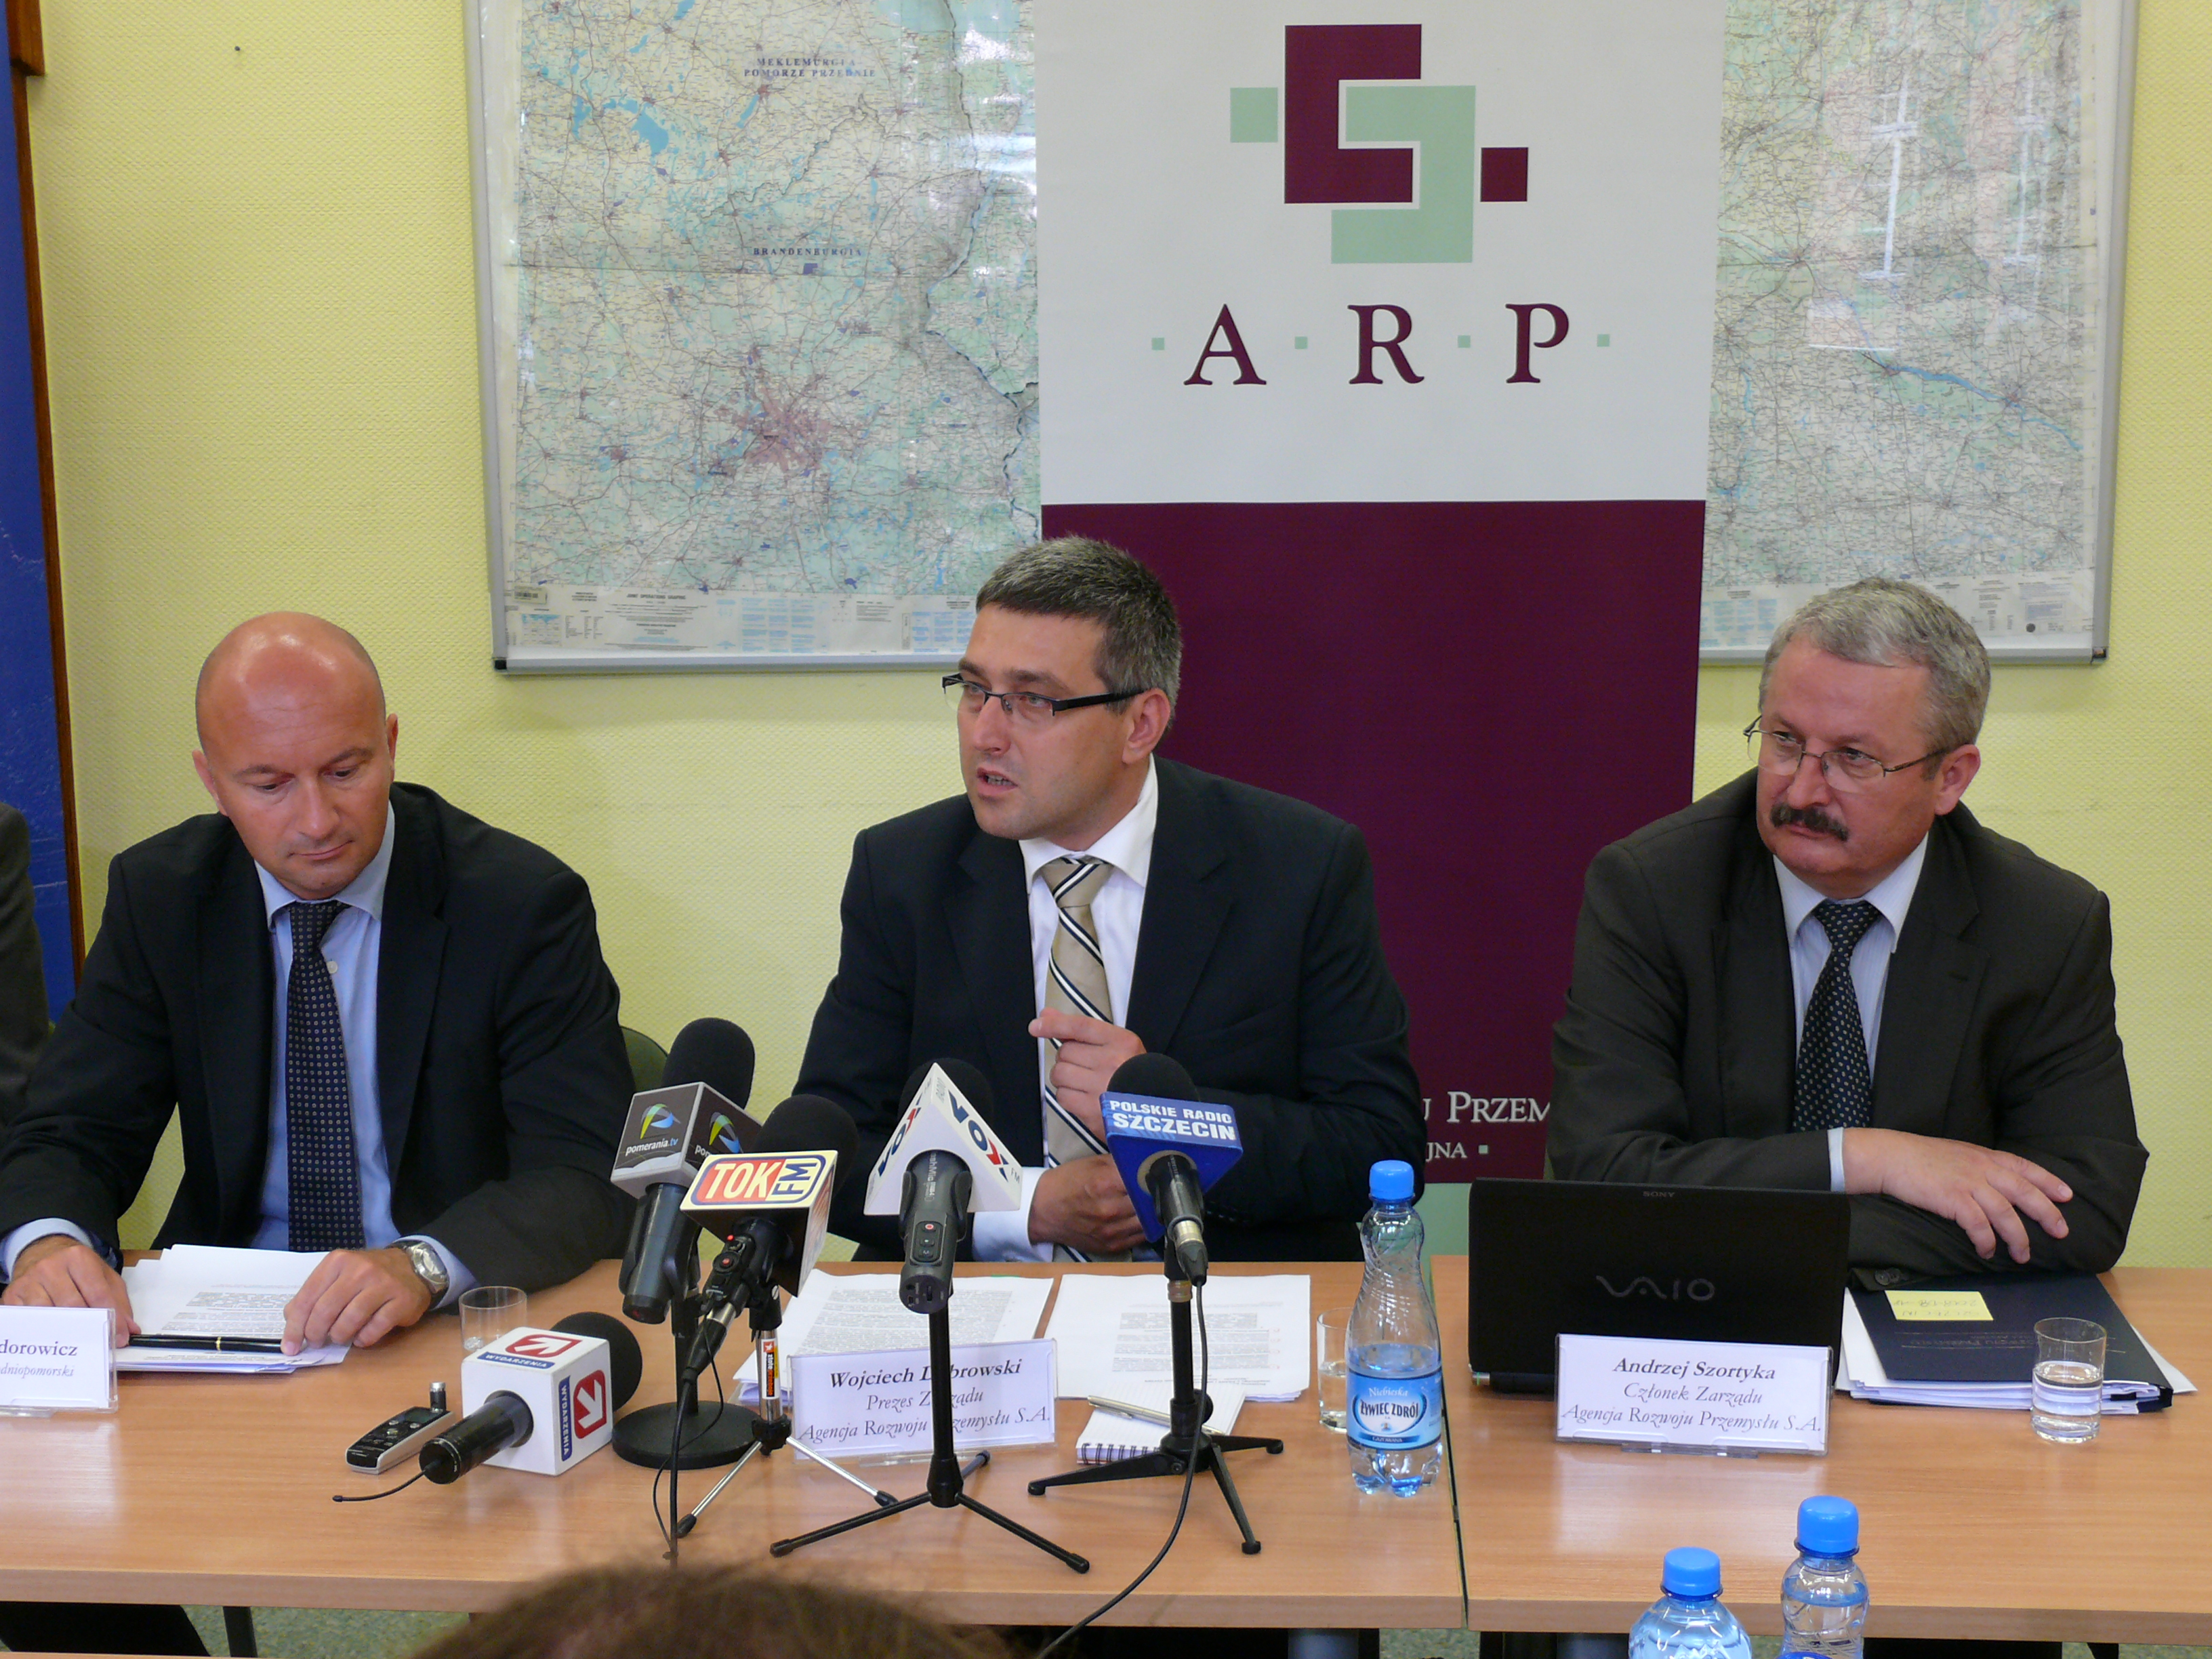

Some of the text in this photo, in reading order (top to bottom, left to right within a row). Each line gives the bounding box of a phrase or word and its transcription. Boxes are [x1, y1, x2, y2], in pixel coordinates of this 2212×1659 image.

[744, 69, 805, 77] POMORZE
[753, 247, 862, 256] BRANDENBURGIA
[1183, 302, 1570, 386] A R P
[1109, 1100, 1233, 1124] POLSKIE RADIO
[1112, 1112, 1237, 1141] SZCZECIN
[625, 1138, 678, 1157] pomerania.tv
[705, 1161, 817, 1200] TOK FM
[1595, 1275, 1716, 1301] VAIO
[485, 1353, 548, 1368] WYDARZENIA
[1613, 1357, 1776, 1383] Andrzej Szortyka
[830, 1359, 1023, 1391] Wojciech Dbrowski
[866, 1394, 914, 1414] Prezes
[1623, 1382, 1763, 1408] Członek Zarządu
[560, 1385, 571, 1456] WYDARZENIA
[797, 1406, 1050, 1444] Agencja Rozwoju zemysłu S.A.
[1561, 1404, 1822, 1433] Agencja Rozwoju Przemysłu S.A.
